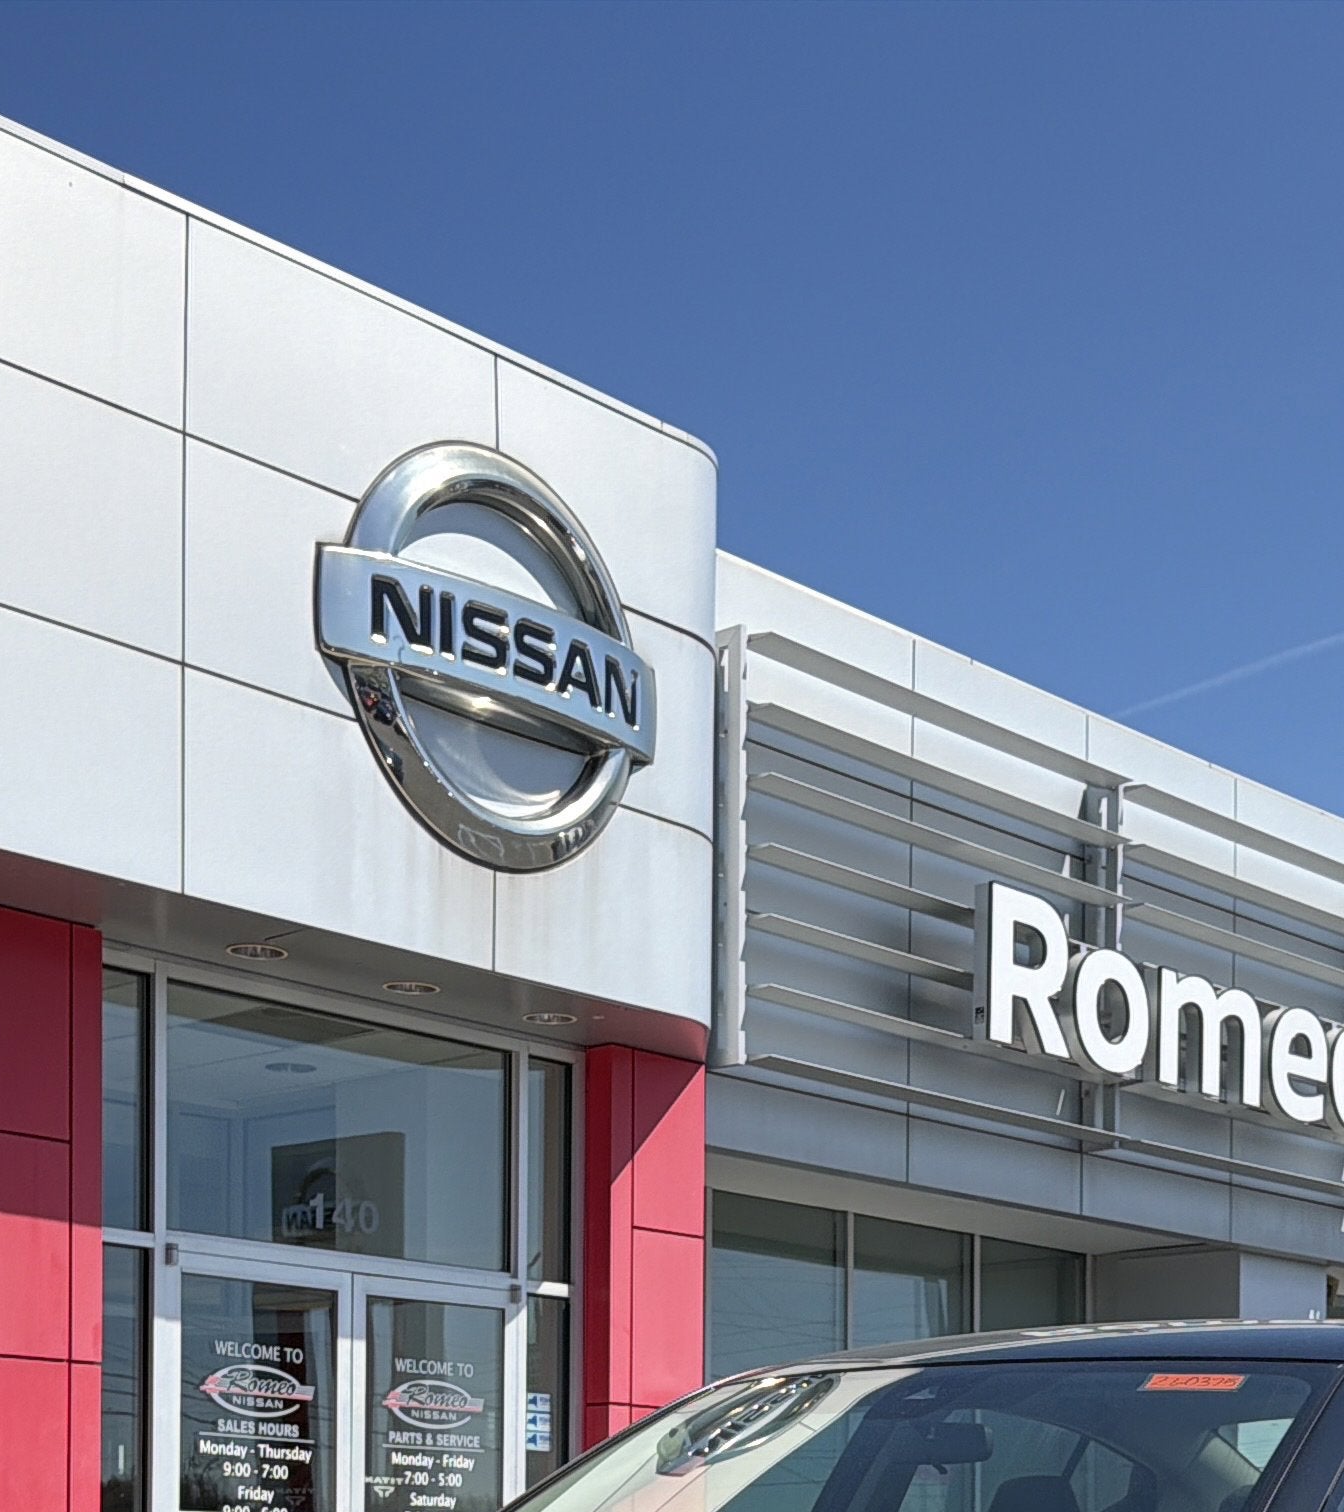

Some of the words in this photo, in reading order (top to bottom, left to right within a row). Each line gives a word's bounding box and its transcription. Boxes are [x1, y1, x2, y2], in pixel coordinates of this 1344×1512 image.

[369, 573, 641, 732] NISSAN
[309, 1193, 380, 1234] 140
[214, 1340, 281, 1362] WELCOME
[283, 1347, 304, 1364] TO
[395, 1358, 454, 1376] WELCOME
[457, 1362, 474, 1378] TO
[218, 1367, 297, 1396] Romeo
[232, 1395, 284, 1409] NISSAN
[402, 1382, 468, 1408] Romeo
[411, 1409, 457, 1421] NISSAN
[217, 1418, 255, 1434] SALES
[257, 1421, 300, 1438] HOURS
[388, 1431, 422, 1445] PARTS
[425, 1433, 434, 1446] &
[436, 1434, 481, 1448] SERVICE
[199, 1439, 248, 1460] Monday
[257, 1443, 313, 1464] Thursday
[391, 1451, 434, 1470] Monday
[442, 1454, 475, 1472] Friday
[223, 1461, 251, 1477] 9:00
[261, 1463, 289, 1480] 7:00
[404, 1471, 429, 1486] 7:00
[438, 1472, 462, 1487] 5:00
[237, 1485, 275, 1504] Friday
[410, 1492, 457, 1510] Saturday
